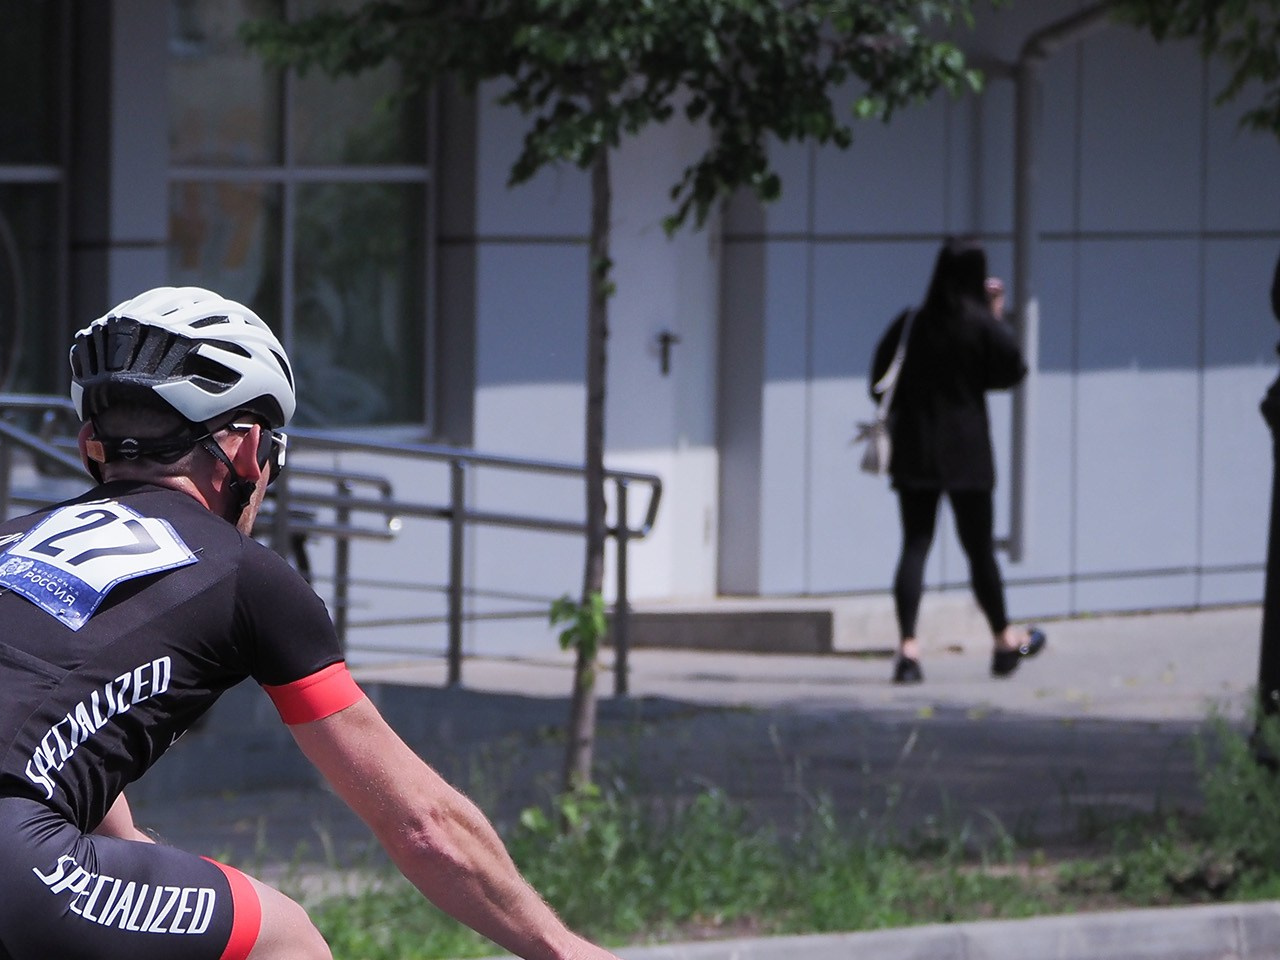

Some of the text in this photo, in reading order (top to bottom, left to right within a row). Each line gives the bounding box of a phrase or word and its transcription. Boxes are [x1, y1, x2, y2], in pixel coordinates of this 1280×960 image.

[30, 509, 161, 566] 27
[23, 571, 76, 607] РОССИЯ
[25, 655, 171, 800] SPECIALIZED
